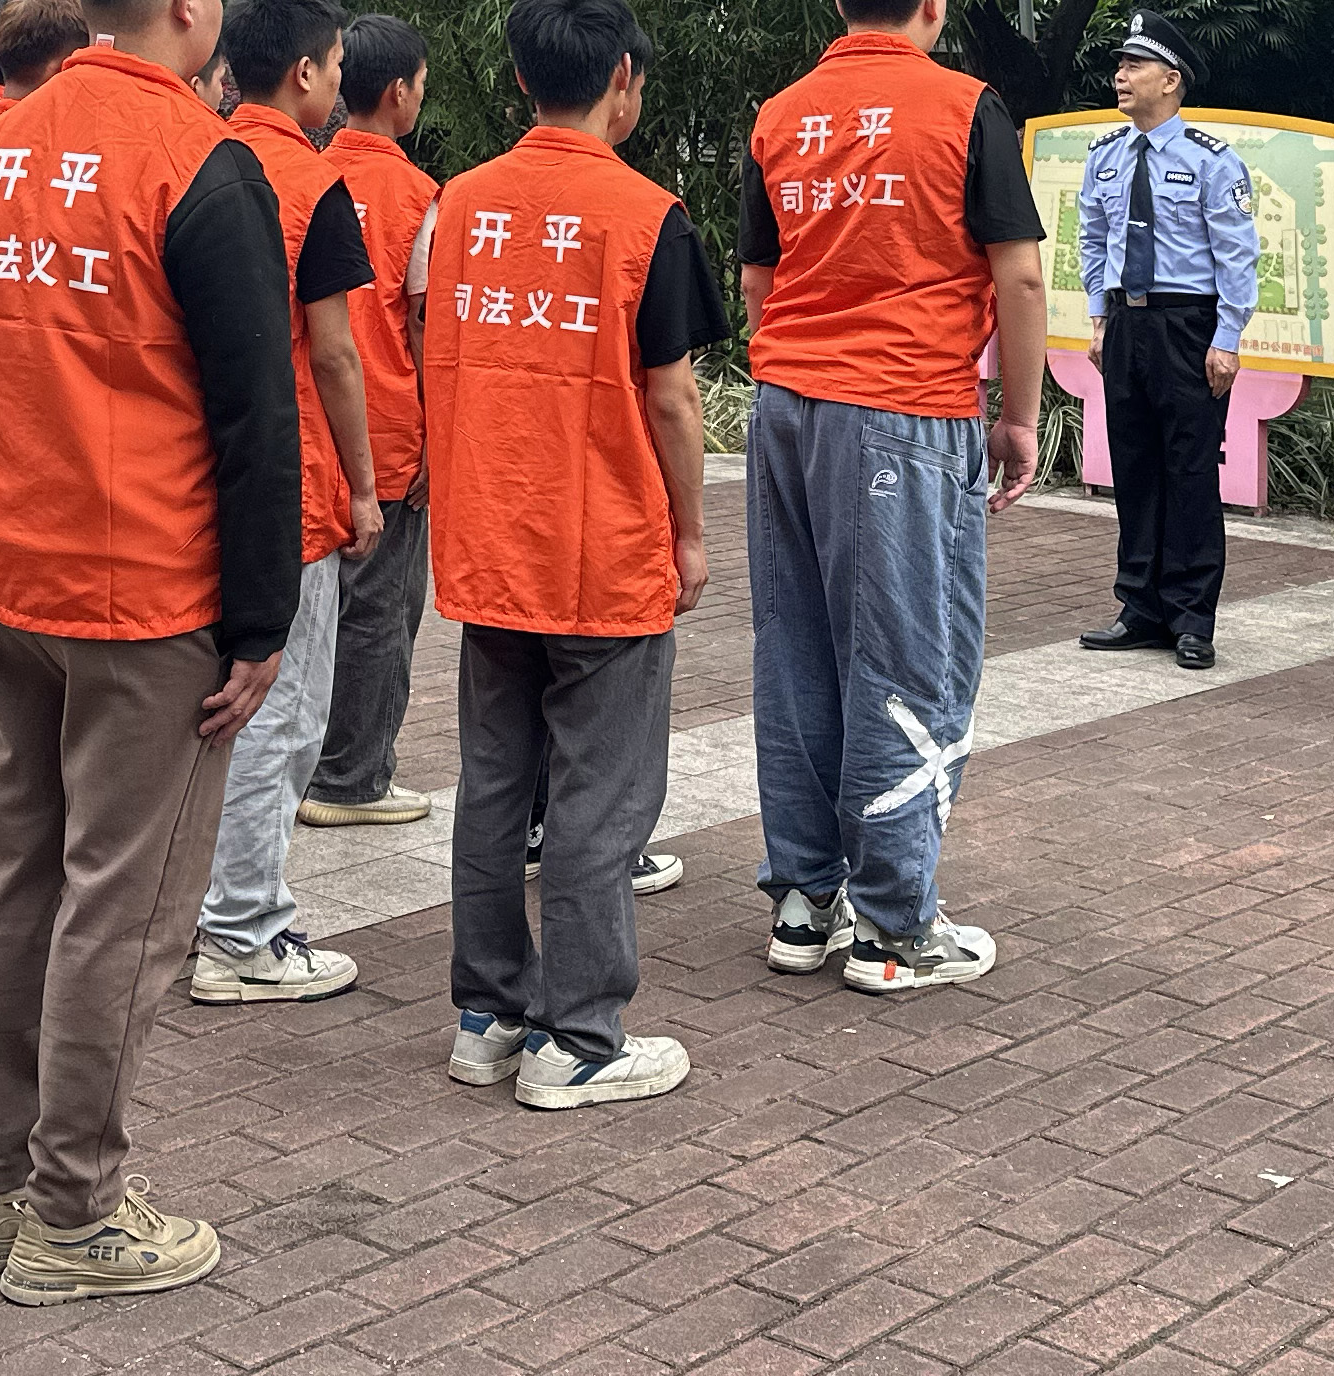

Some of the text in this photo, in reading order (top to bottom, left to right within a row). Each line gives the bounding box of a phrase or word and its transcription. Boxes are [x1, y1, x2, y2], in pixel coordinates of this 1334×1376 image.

[796, 107, 894, 156] 开平
[780, 173, 906, 214] 司法义工
[468, 210, 583, 263] 开平
[454, 283, 600, 333] 司法义工
[87, 1244, 126, 1263] GET
